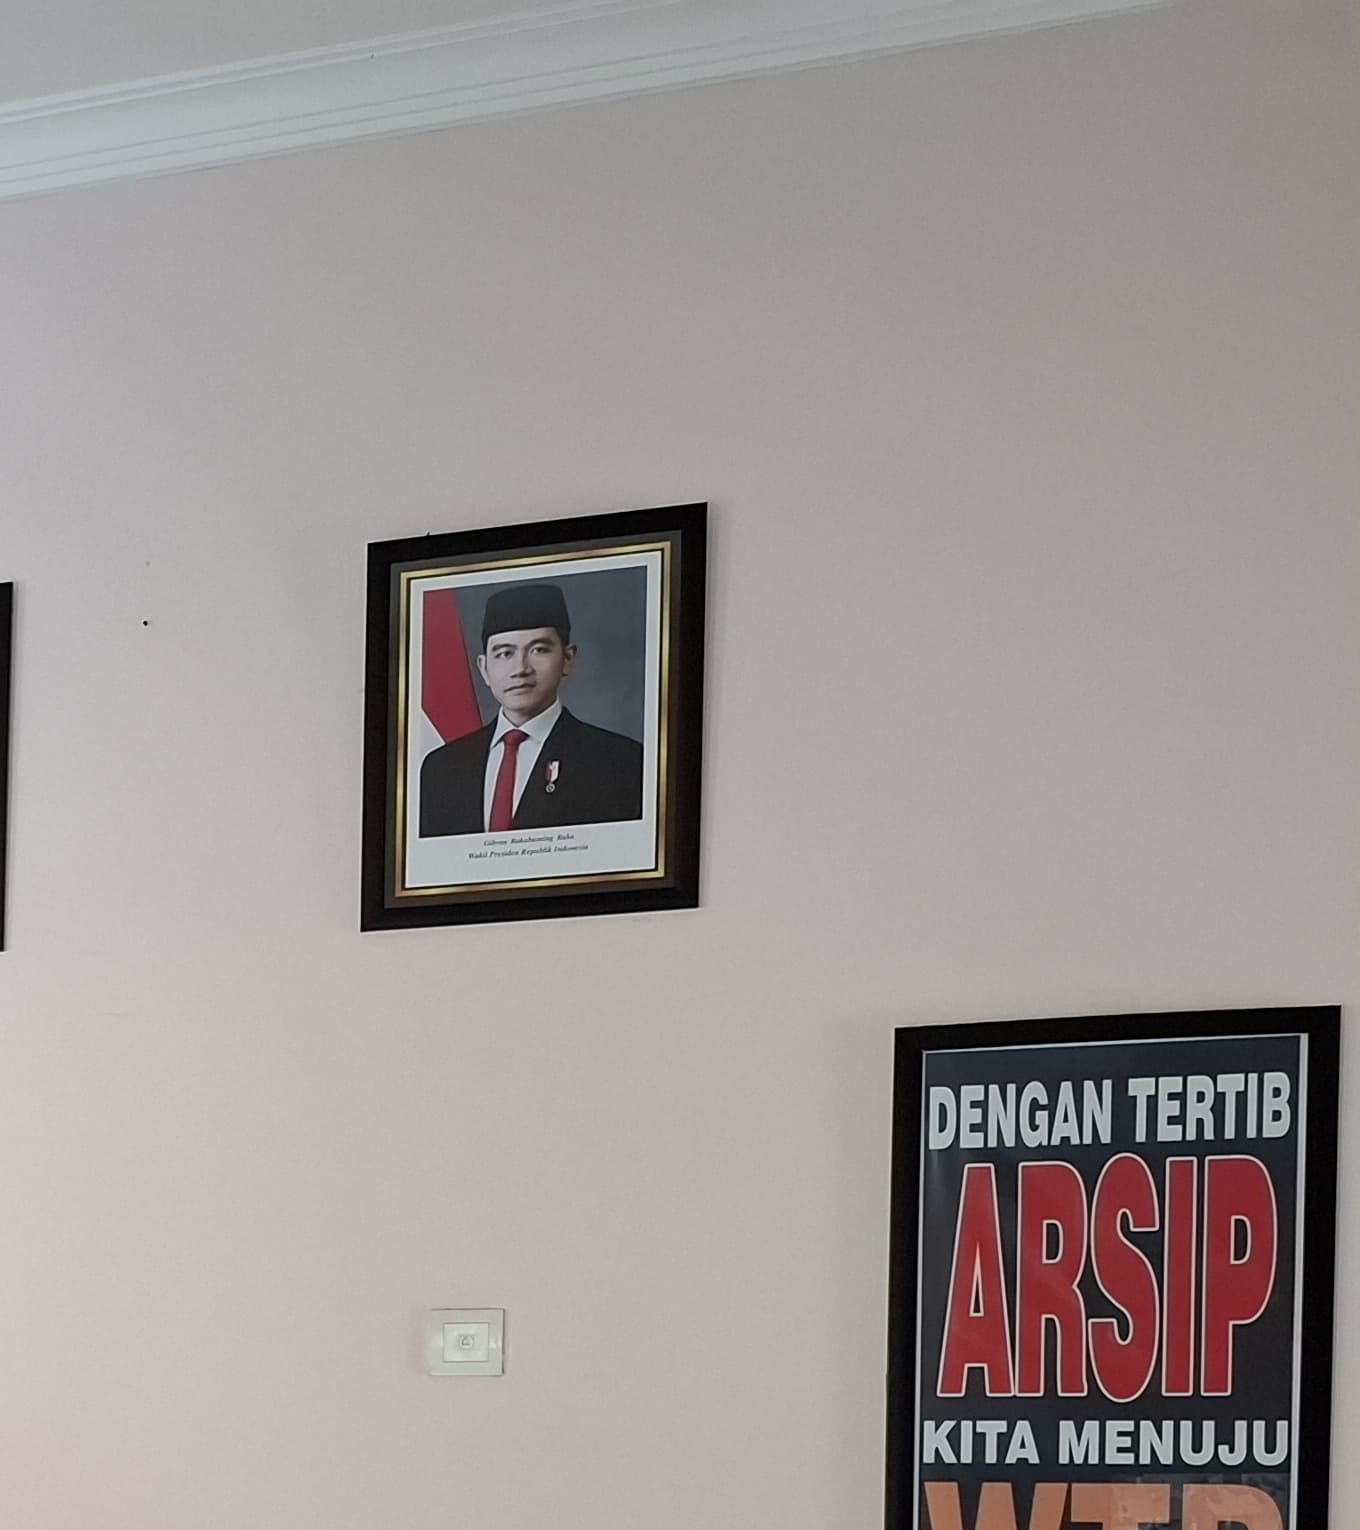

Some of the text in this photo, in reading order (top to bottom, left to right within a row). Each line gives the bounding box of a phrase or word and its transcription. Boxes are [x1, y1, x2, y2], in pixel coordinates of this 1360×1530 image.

[489, 849, 519, 858] Presiden
[926, 1070, 1292, 1152] DENGAN TERTIB
[936, 1151, 1278, 1403] ARSIP
[922, 1418, 1290, 1467] KITA MENUJU
